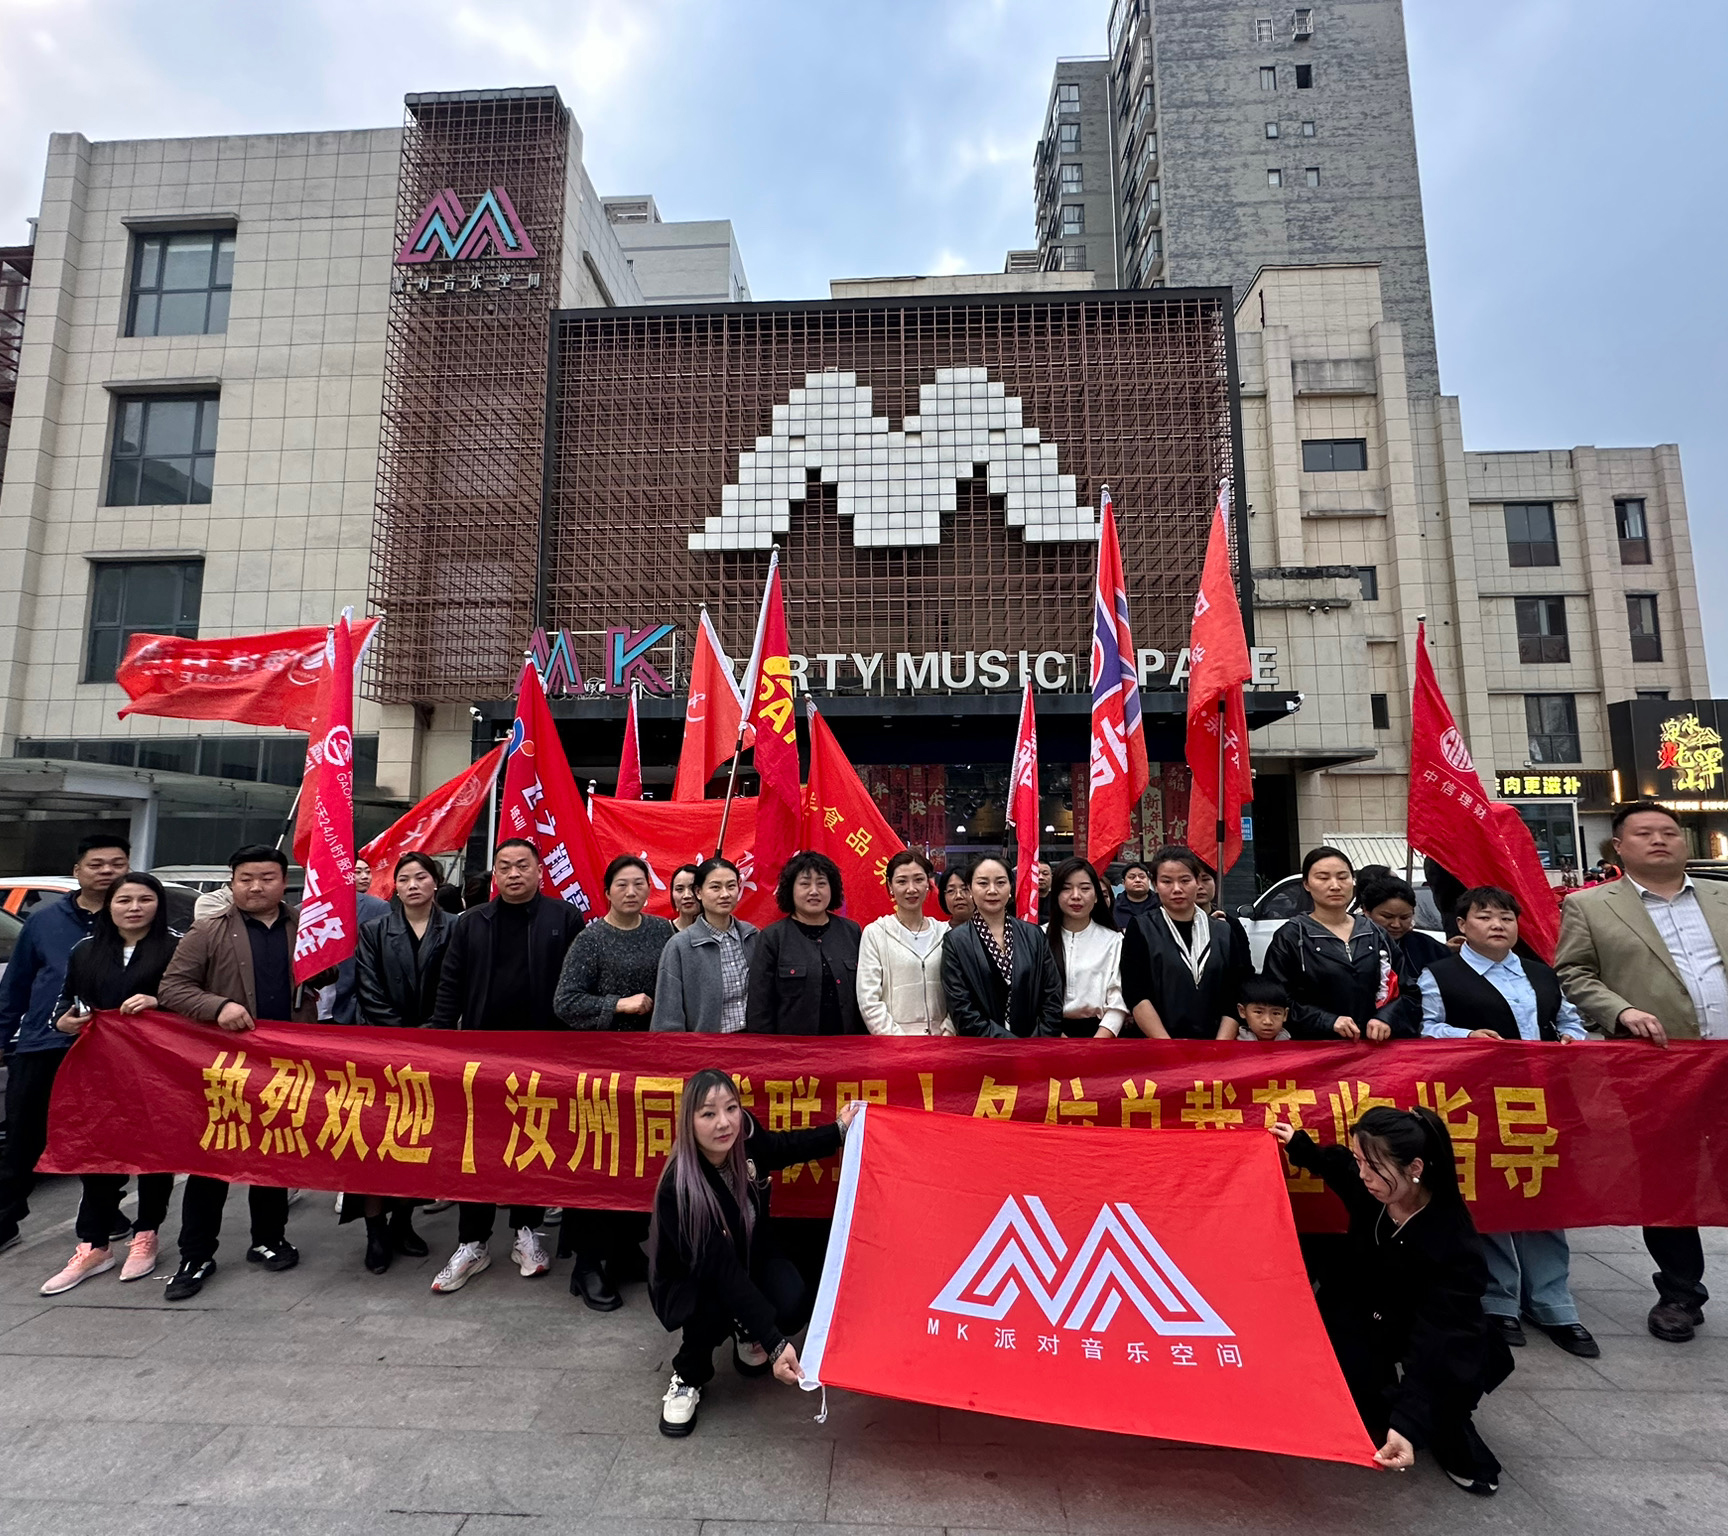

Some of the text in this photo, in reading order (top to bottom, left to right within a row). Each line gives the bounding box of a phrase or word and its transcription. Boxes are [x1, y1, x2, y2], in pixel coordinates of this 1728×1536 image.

[896, 649, 1068, 690] MUSIC
[1423, 769, 1487, 820] 中信理财
